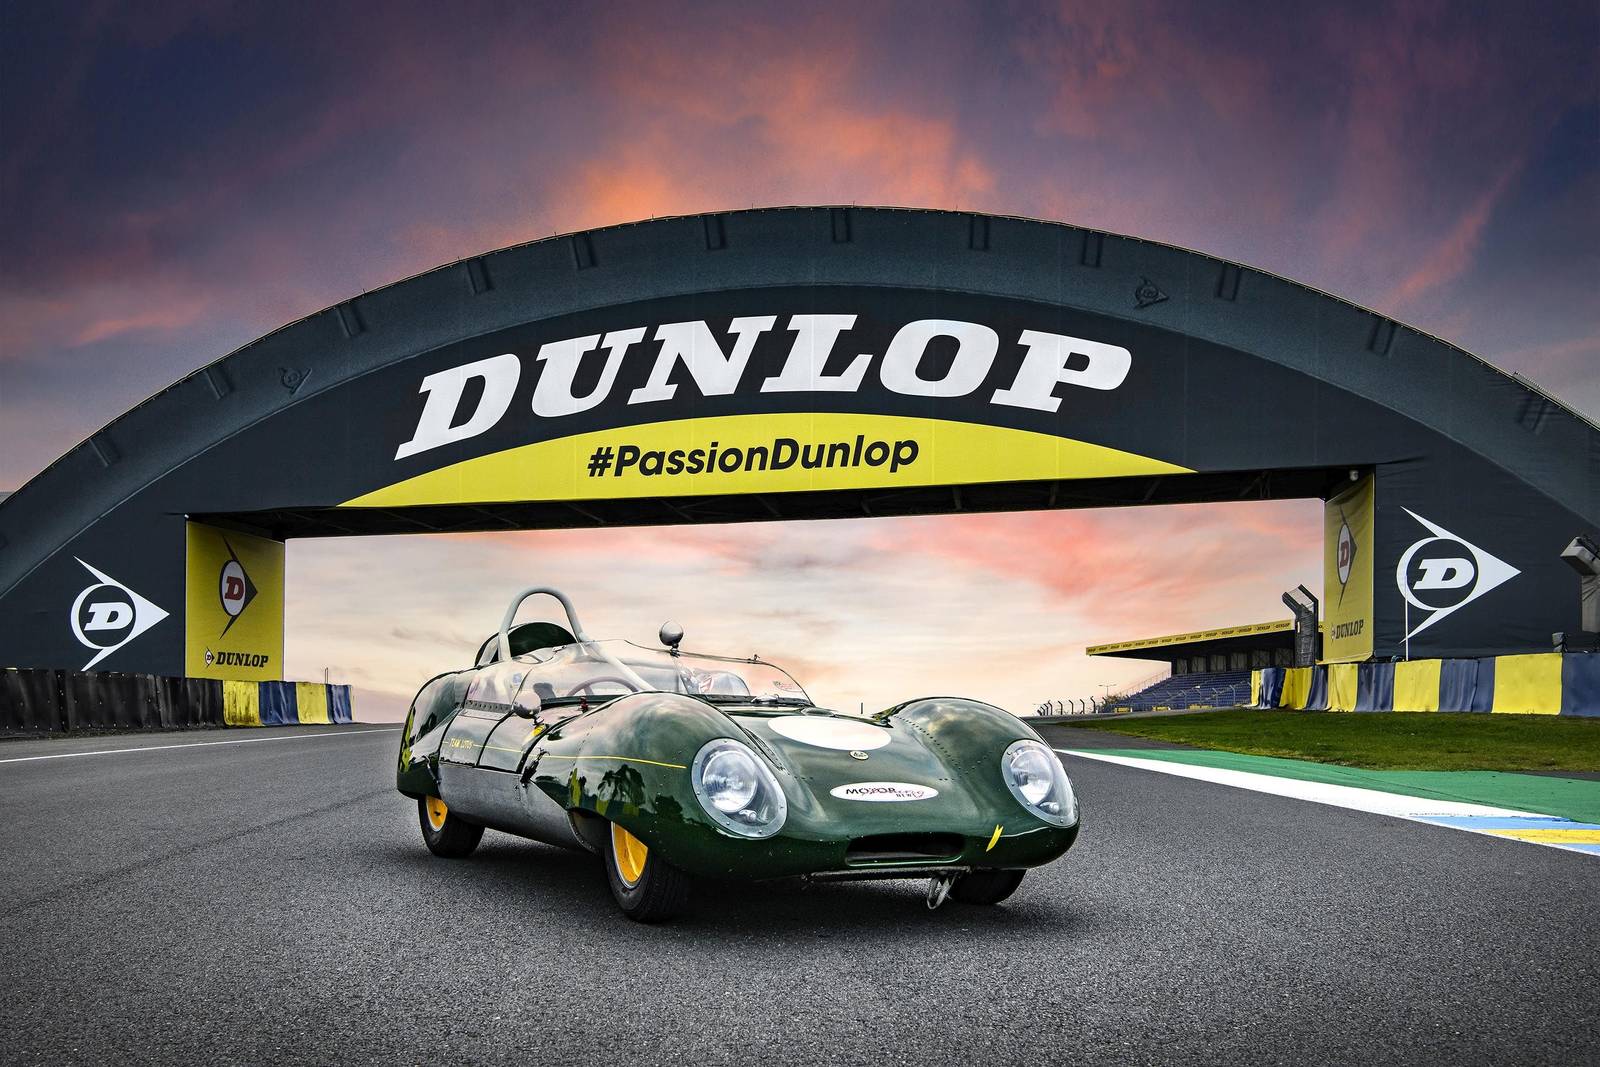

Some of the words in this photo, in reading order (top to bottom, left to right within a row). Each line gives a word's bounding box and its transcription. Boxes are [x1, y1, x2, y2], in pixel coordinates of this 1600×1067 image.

[395, 314, 1132, 461] DUNLOP
[587, 434, 920, 479] #PassionDunlop
[1339, 540, 1350, 568] D
[1412, 557, 1474, 590] D
[224, 576, 244, 600] D
[84, 602, 133, 631] D
[1335, 619, 1364, 640] DUNLOP
[215, 651, 269, 668] DUNLOP
